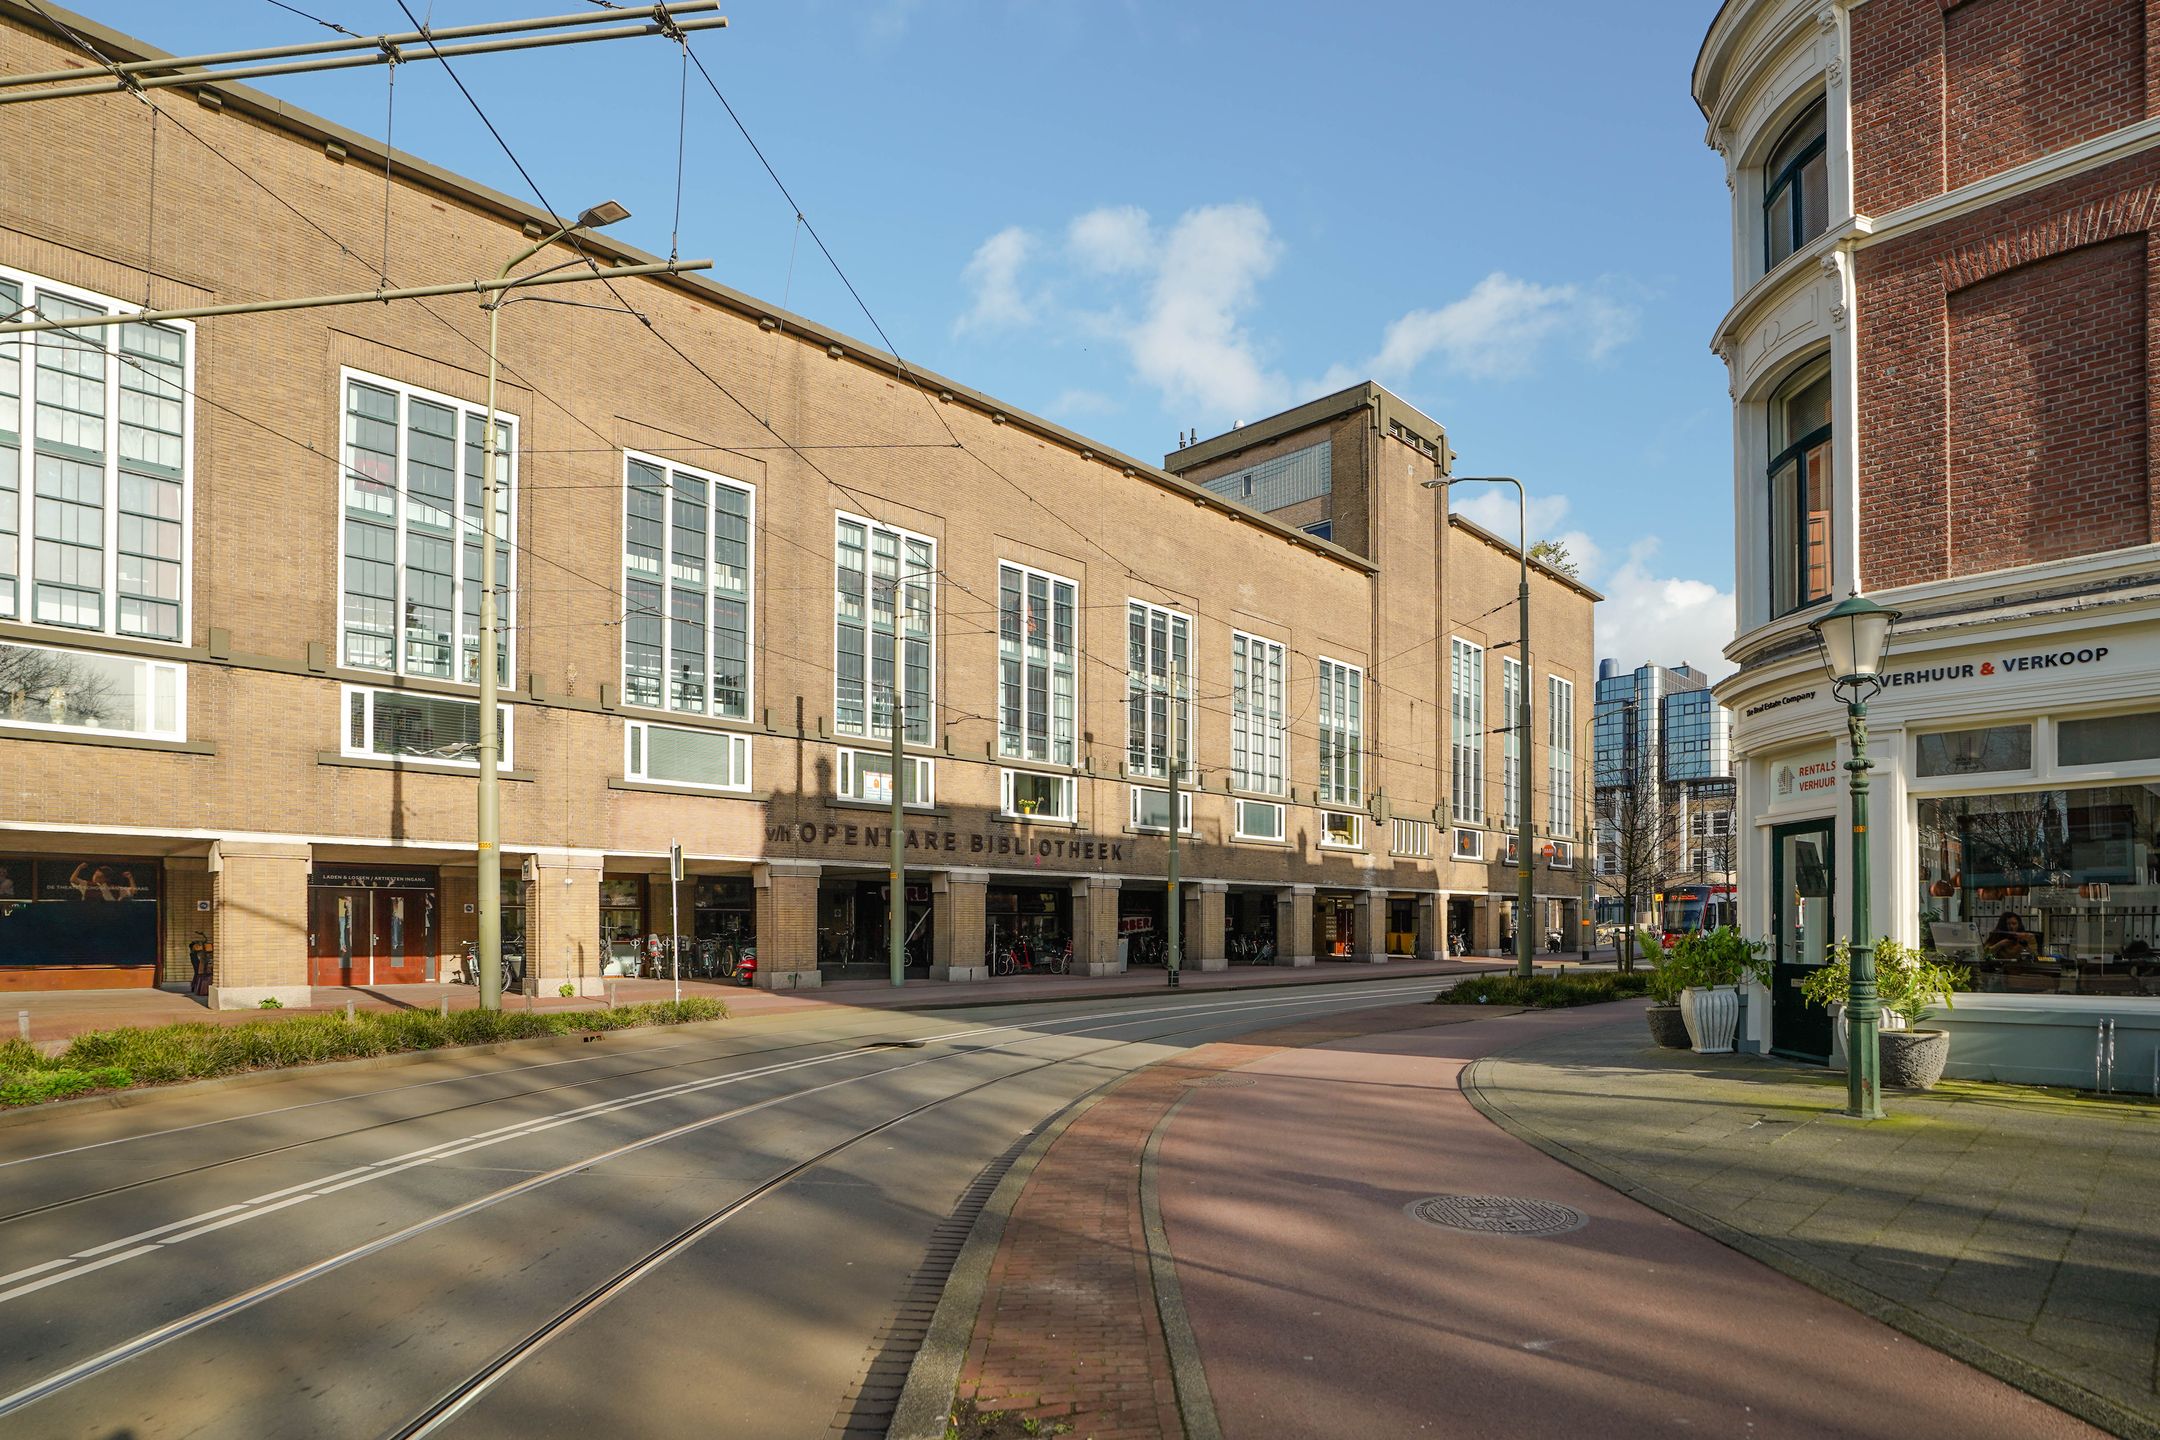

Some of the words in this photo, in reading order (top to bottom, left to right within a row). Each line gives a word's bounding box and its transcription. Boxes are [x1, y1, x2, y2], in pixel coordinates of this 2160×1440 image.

[1879, 664, 1974, 688] VERHUUR
[1979, 662, 1995, 676] &
[2002, 647, 2109, 673] VERKOOP
[1754, 704, 1764, 714] Real
[1764, 700, 1782, 710] Estate
[1782, 691, 1816, 705] Company
[1799, 760, 1836, 777] RENTALS
[1799, 777, 1836, 792] VERHUUR
[970, 834, 1122, 861] BIBLIOTHEEK
